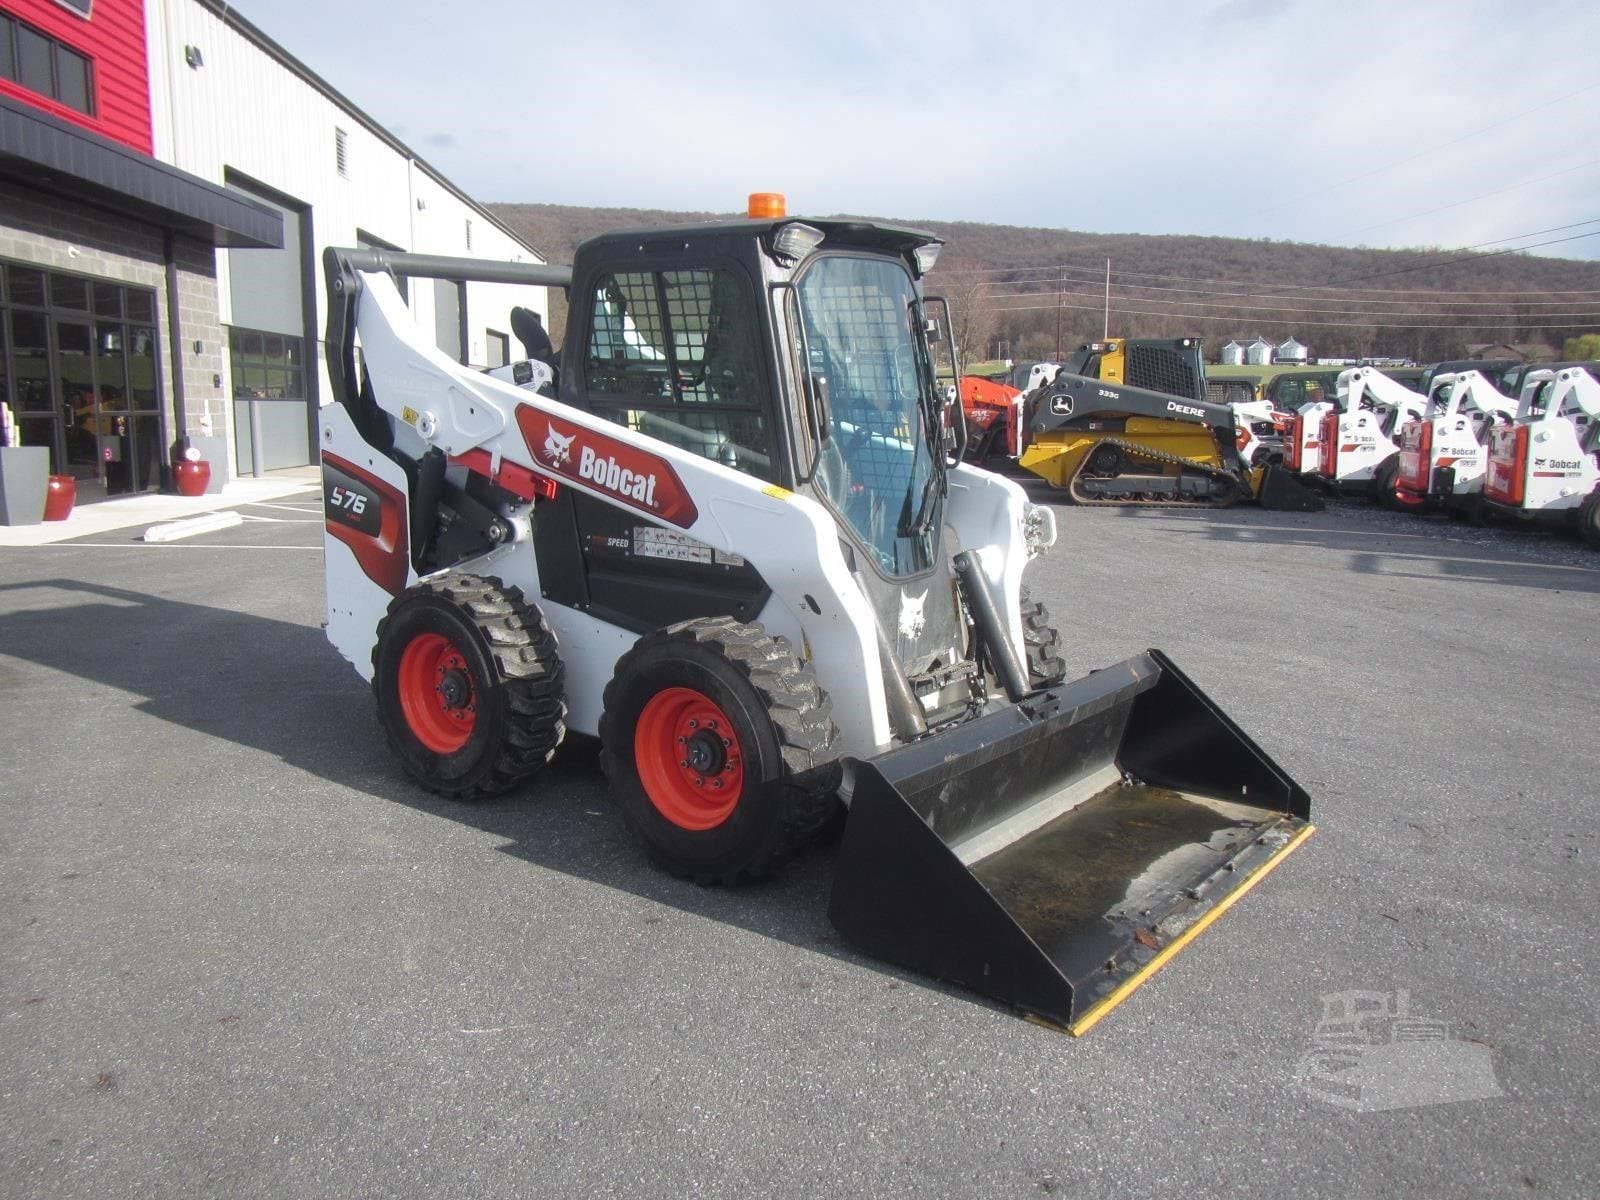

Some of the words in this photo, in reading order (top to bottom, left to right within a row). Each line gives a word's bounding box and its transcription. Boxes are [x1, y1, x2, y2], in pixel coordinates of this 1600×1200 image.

[1166, 401, 1206, 417] DEERE
[1451, 447, 1476, 456] Bobcat
[1549, 459, 1581, 469] Bobcat
[579, 445, 656, 506] Bobcat
[331, 486, 368, 514] S76
